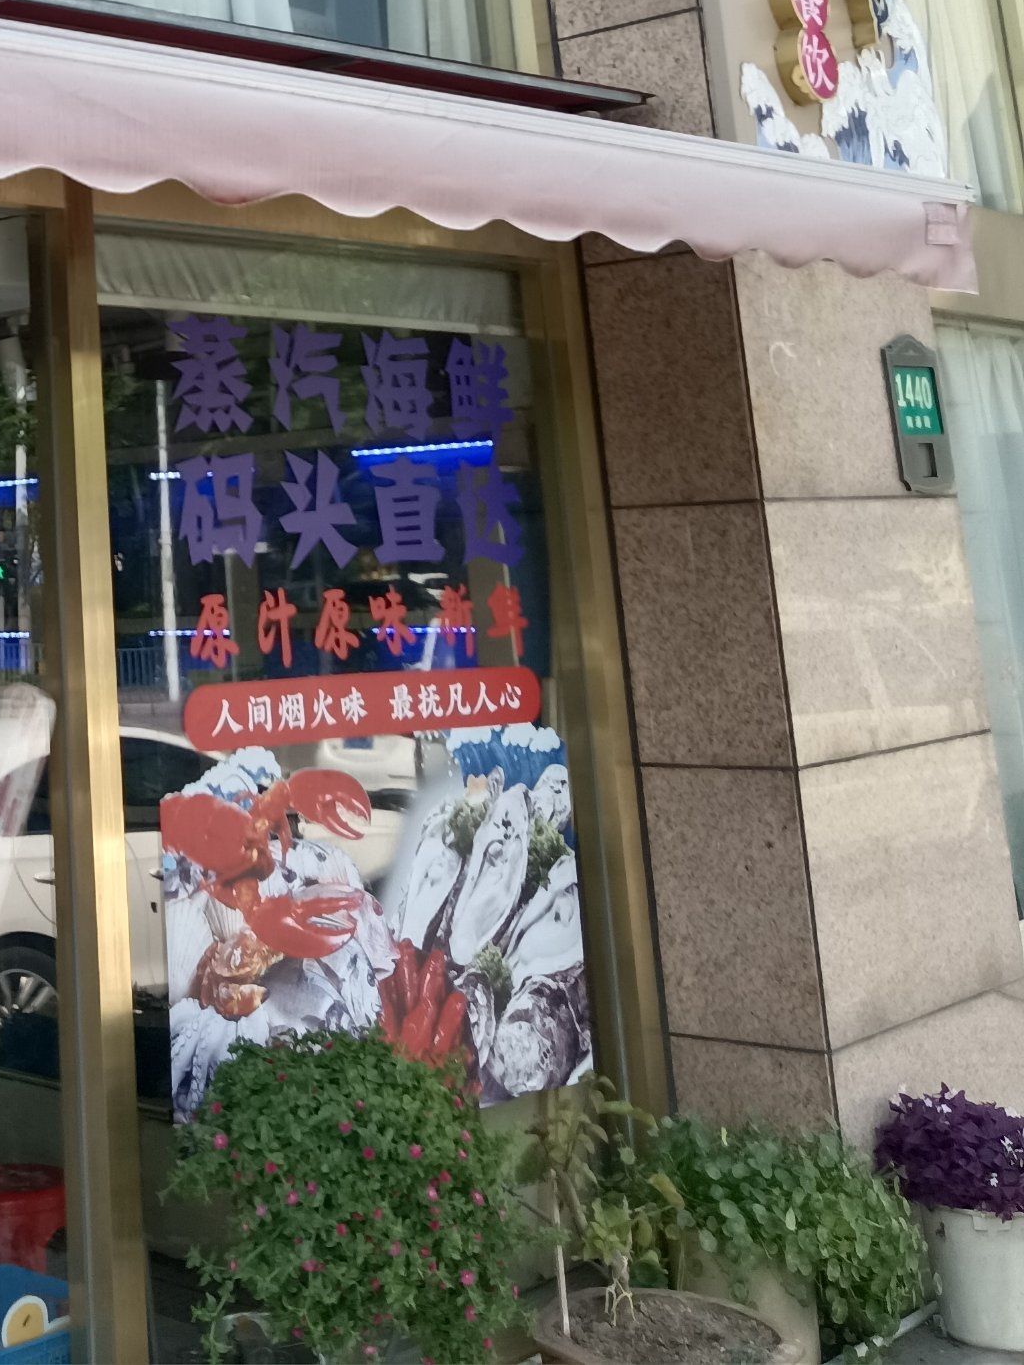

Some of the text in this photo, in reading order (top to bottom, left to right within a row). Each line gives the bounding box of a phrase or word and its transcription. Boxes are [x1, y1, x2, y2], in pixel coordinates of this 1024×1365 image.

[166, 315, 515, 441] 蒸汽海鲜
[895, 373, 933, 410] 1440
[178, 449, 526, 570] 码头直达
[190, 583, 529, 669] 原汁原味新鲜
[211, 681, 522, 737] 人间烟火味 最抚凡人心
